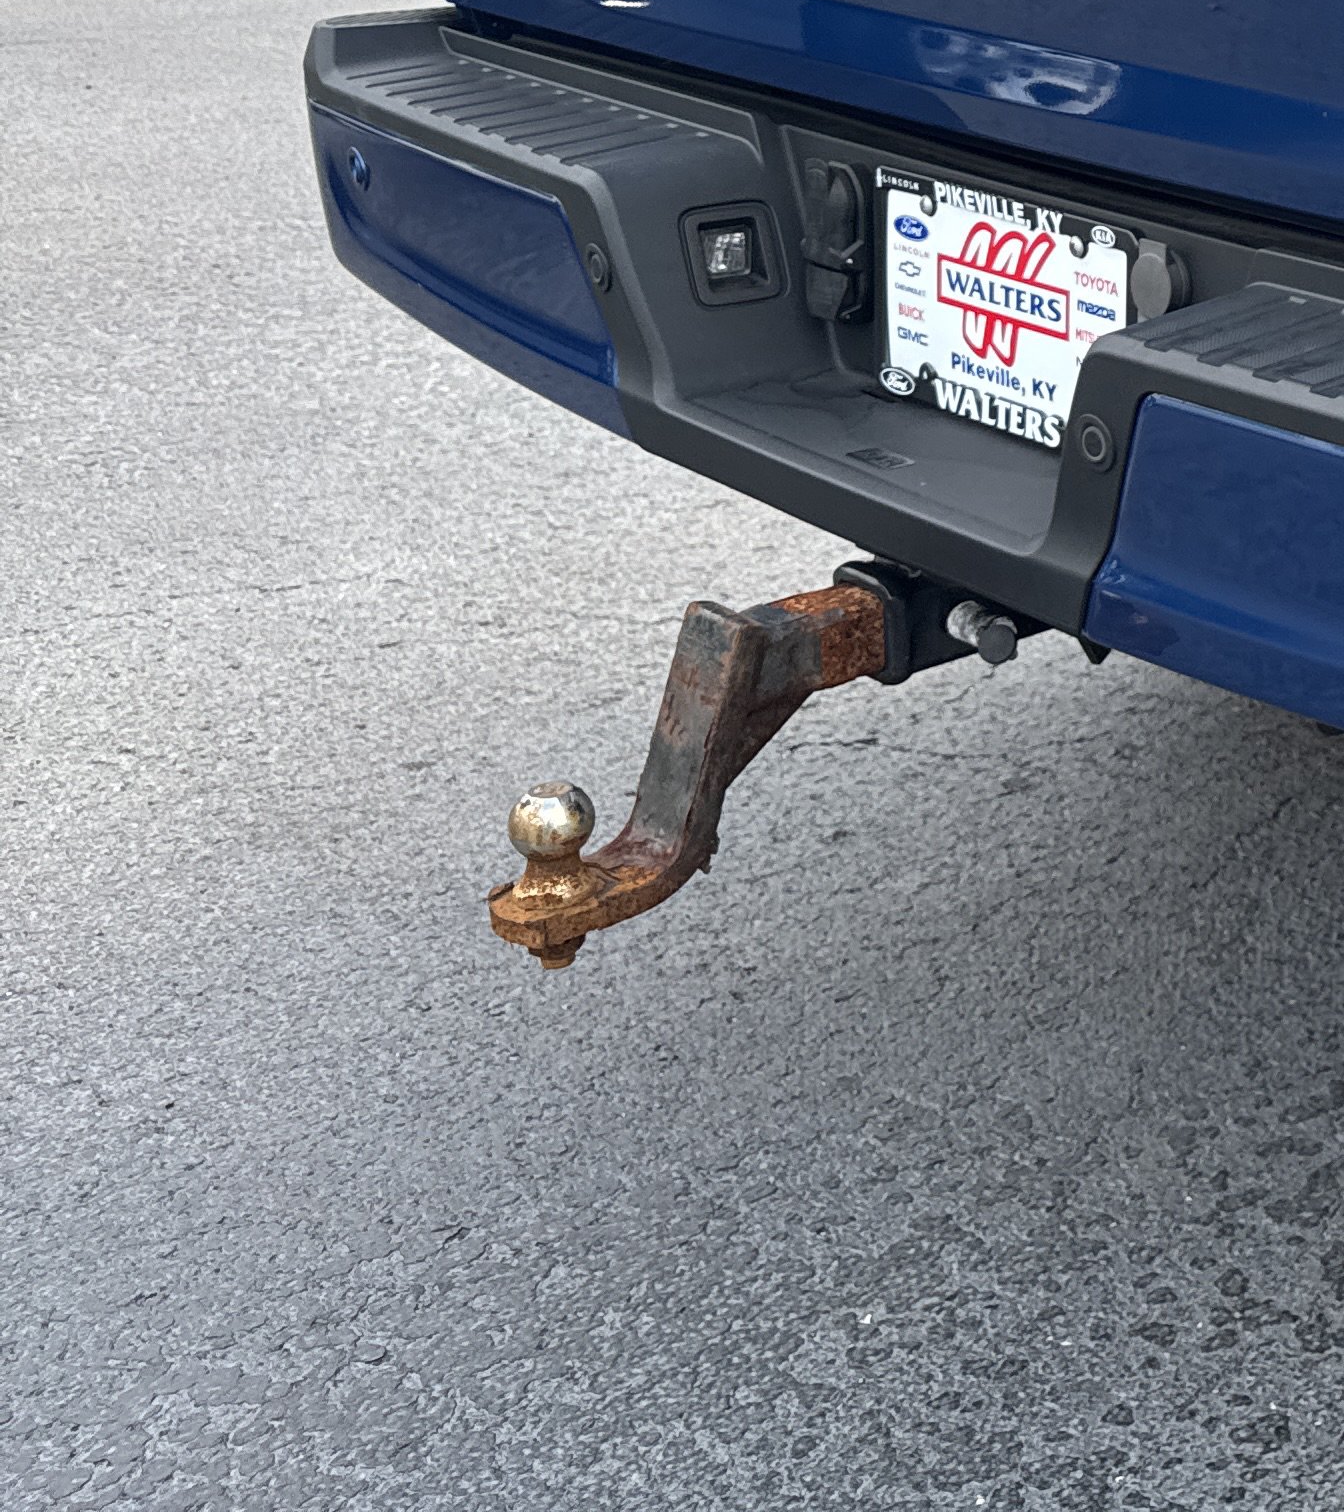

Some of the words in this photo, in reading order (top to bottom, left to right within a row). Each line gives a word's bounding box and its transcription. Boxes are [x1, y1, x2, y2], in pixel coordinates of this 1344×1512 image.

[882, 173, 919, 191] LINCOLN
[934, 181, 1033, 227] PIKEVILLE,
[1036, 208, 1063, 234] KY
[893, 242, 931, 259] LINCOLN
[945, 268, 1062, 323] WALTERS
[1074, 271, 1119, 297] TOYOTA
[898, 302, 926, 322] BUICK
[1077, 299, 1117, 322] mazda
[897, 326, 929, 346] GMC
[951, 351, 1026, 397] Pikeville,
[1032, 377, 1058, 403] KY
[934, 377, 1062, 448] WALTERS
